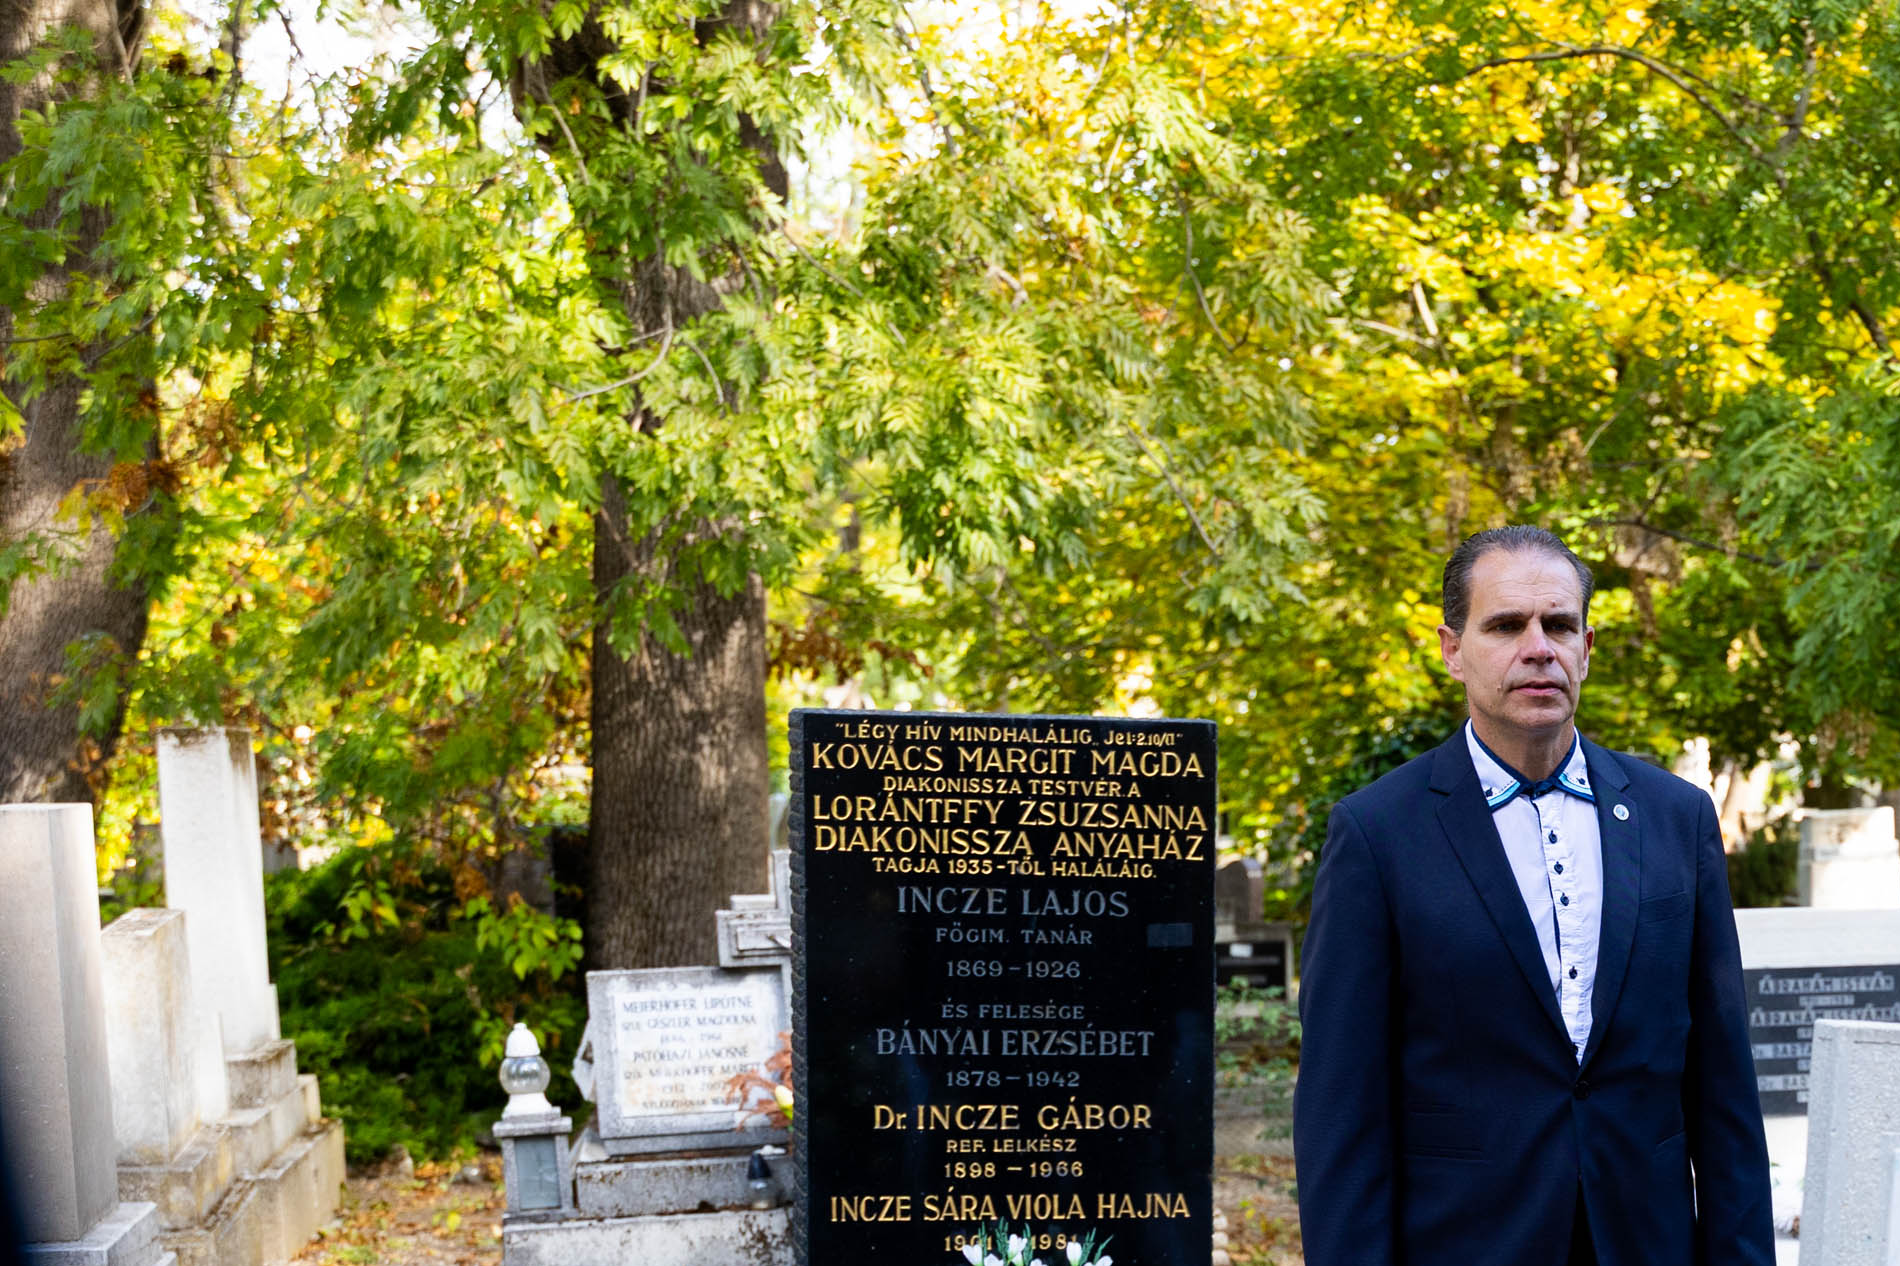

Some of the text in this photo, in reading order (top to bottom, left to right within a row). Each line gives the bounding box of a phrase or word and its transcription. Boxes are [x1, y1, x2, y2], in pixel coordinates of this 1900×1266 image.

[905, 720, 942, 741] HÍV
[812, 739, 1205, 778] KOVÁCS MARGIT MAGDA
[883, 776, 1023, 795] DIAKONISSZA
[813, 792, 1208, 831] LORÁNTFFY ZSUZSANNA
[814, 825, 1205, 861] DIAKONISSZA ANYAHÁZ
[871, 857, 941, 874] TAGJA
[1051, 857, 1157, 879] HALÁLÁIG.
[897, 886, 1130, 918] INCZE LAJOS
[1020, 924, 1094, 945] TANÁR
[941, 998, 1086, 1020] ÉS FELESÉGE
[876, 1019, 1155, 1056] BÁNYAI ERZSÉBET
[873, 1096, 1152, 1131] Dr. INCZE GÁBOR
[946, 1134, 1077, 1153] REF. LELKÉSZ
[830, 1186, 1192, 1222] INCZE SÁRA VIOLA HAJNA
